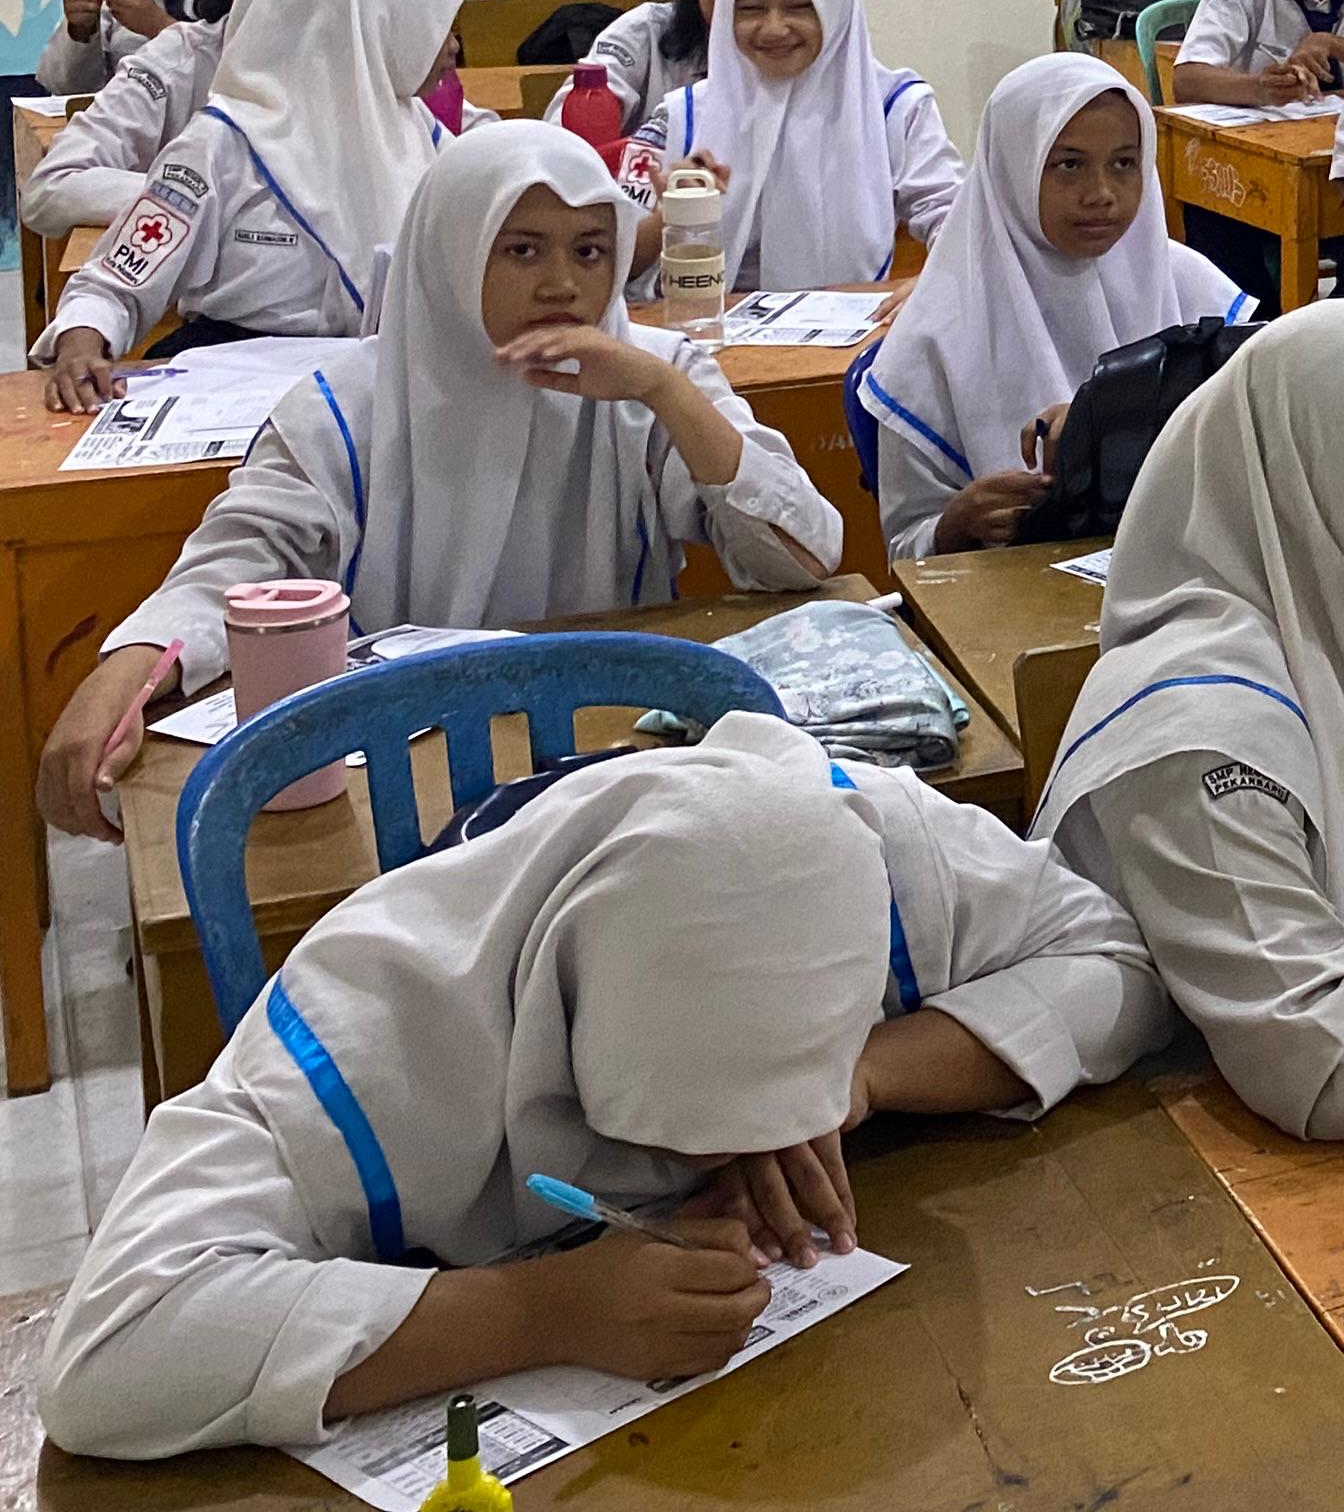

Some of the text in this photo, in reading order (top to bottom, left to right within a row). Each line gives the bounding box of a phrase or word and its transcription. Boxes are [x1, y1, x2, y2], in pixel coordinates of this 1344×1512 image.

[114, 244, 149, 276] PMI
[1208, 767, 1234, 785] SMP
[1214, 776, 1285, 798] PEKANBARU
